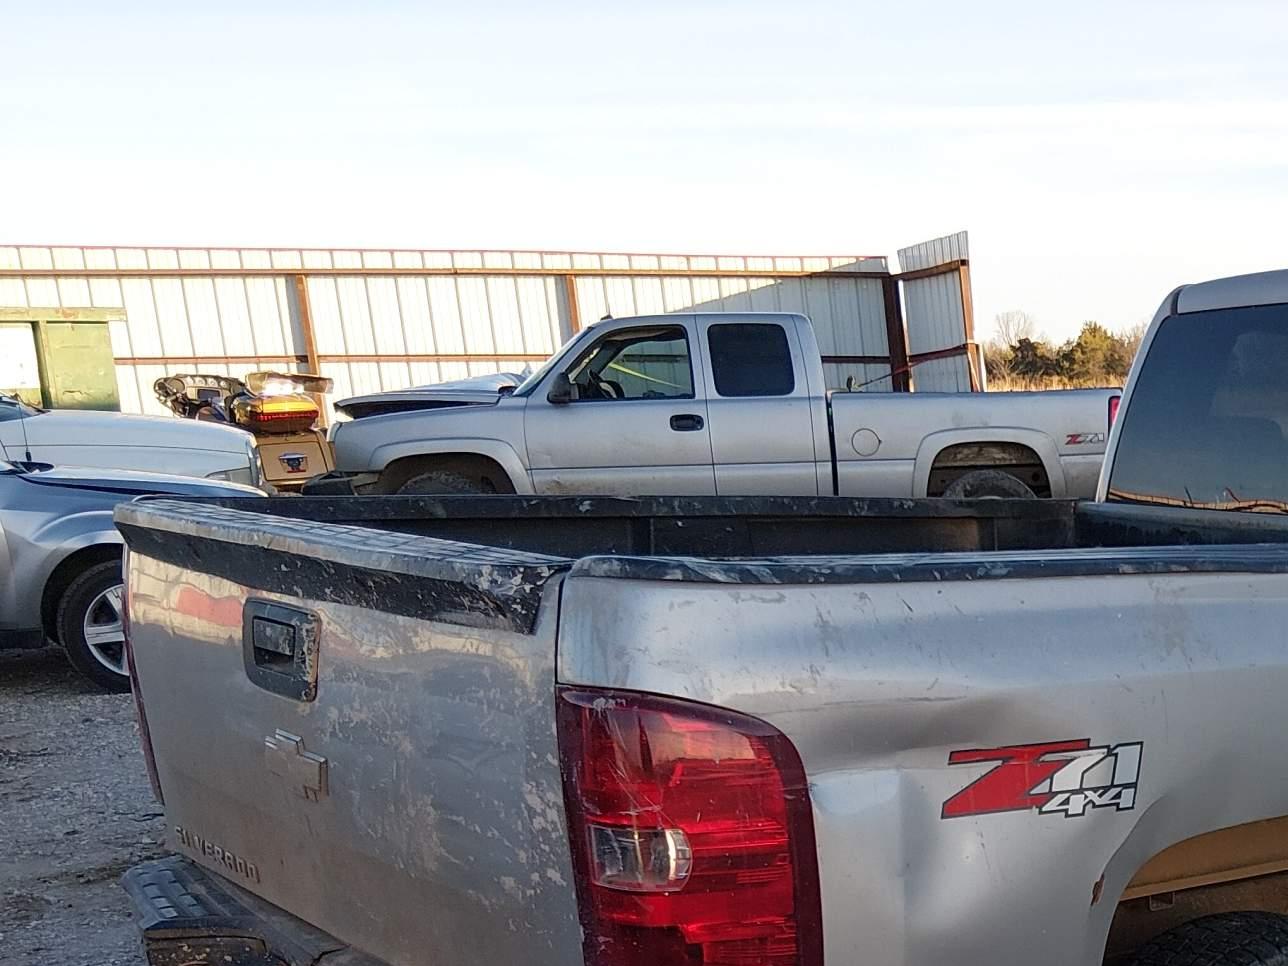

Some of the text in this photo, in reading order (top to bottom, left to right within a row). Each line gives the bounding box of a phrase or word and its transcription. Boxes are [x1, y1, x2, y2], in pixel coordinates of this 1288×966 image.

[1065, 432, 1104, 445] Z71
[941, 738, 1144, 819] Z71
[175, 825, 261, 884] SILVERADO
